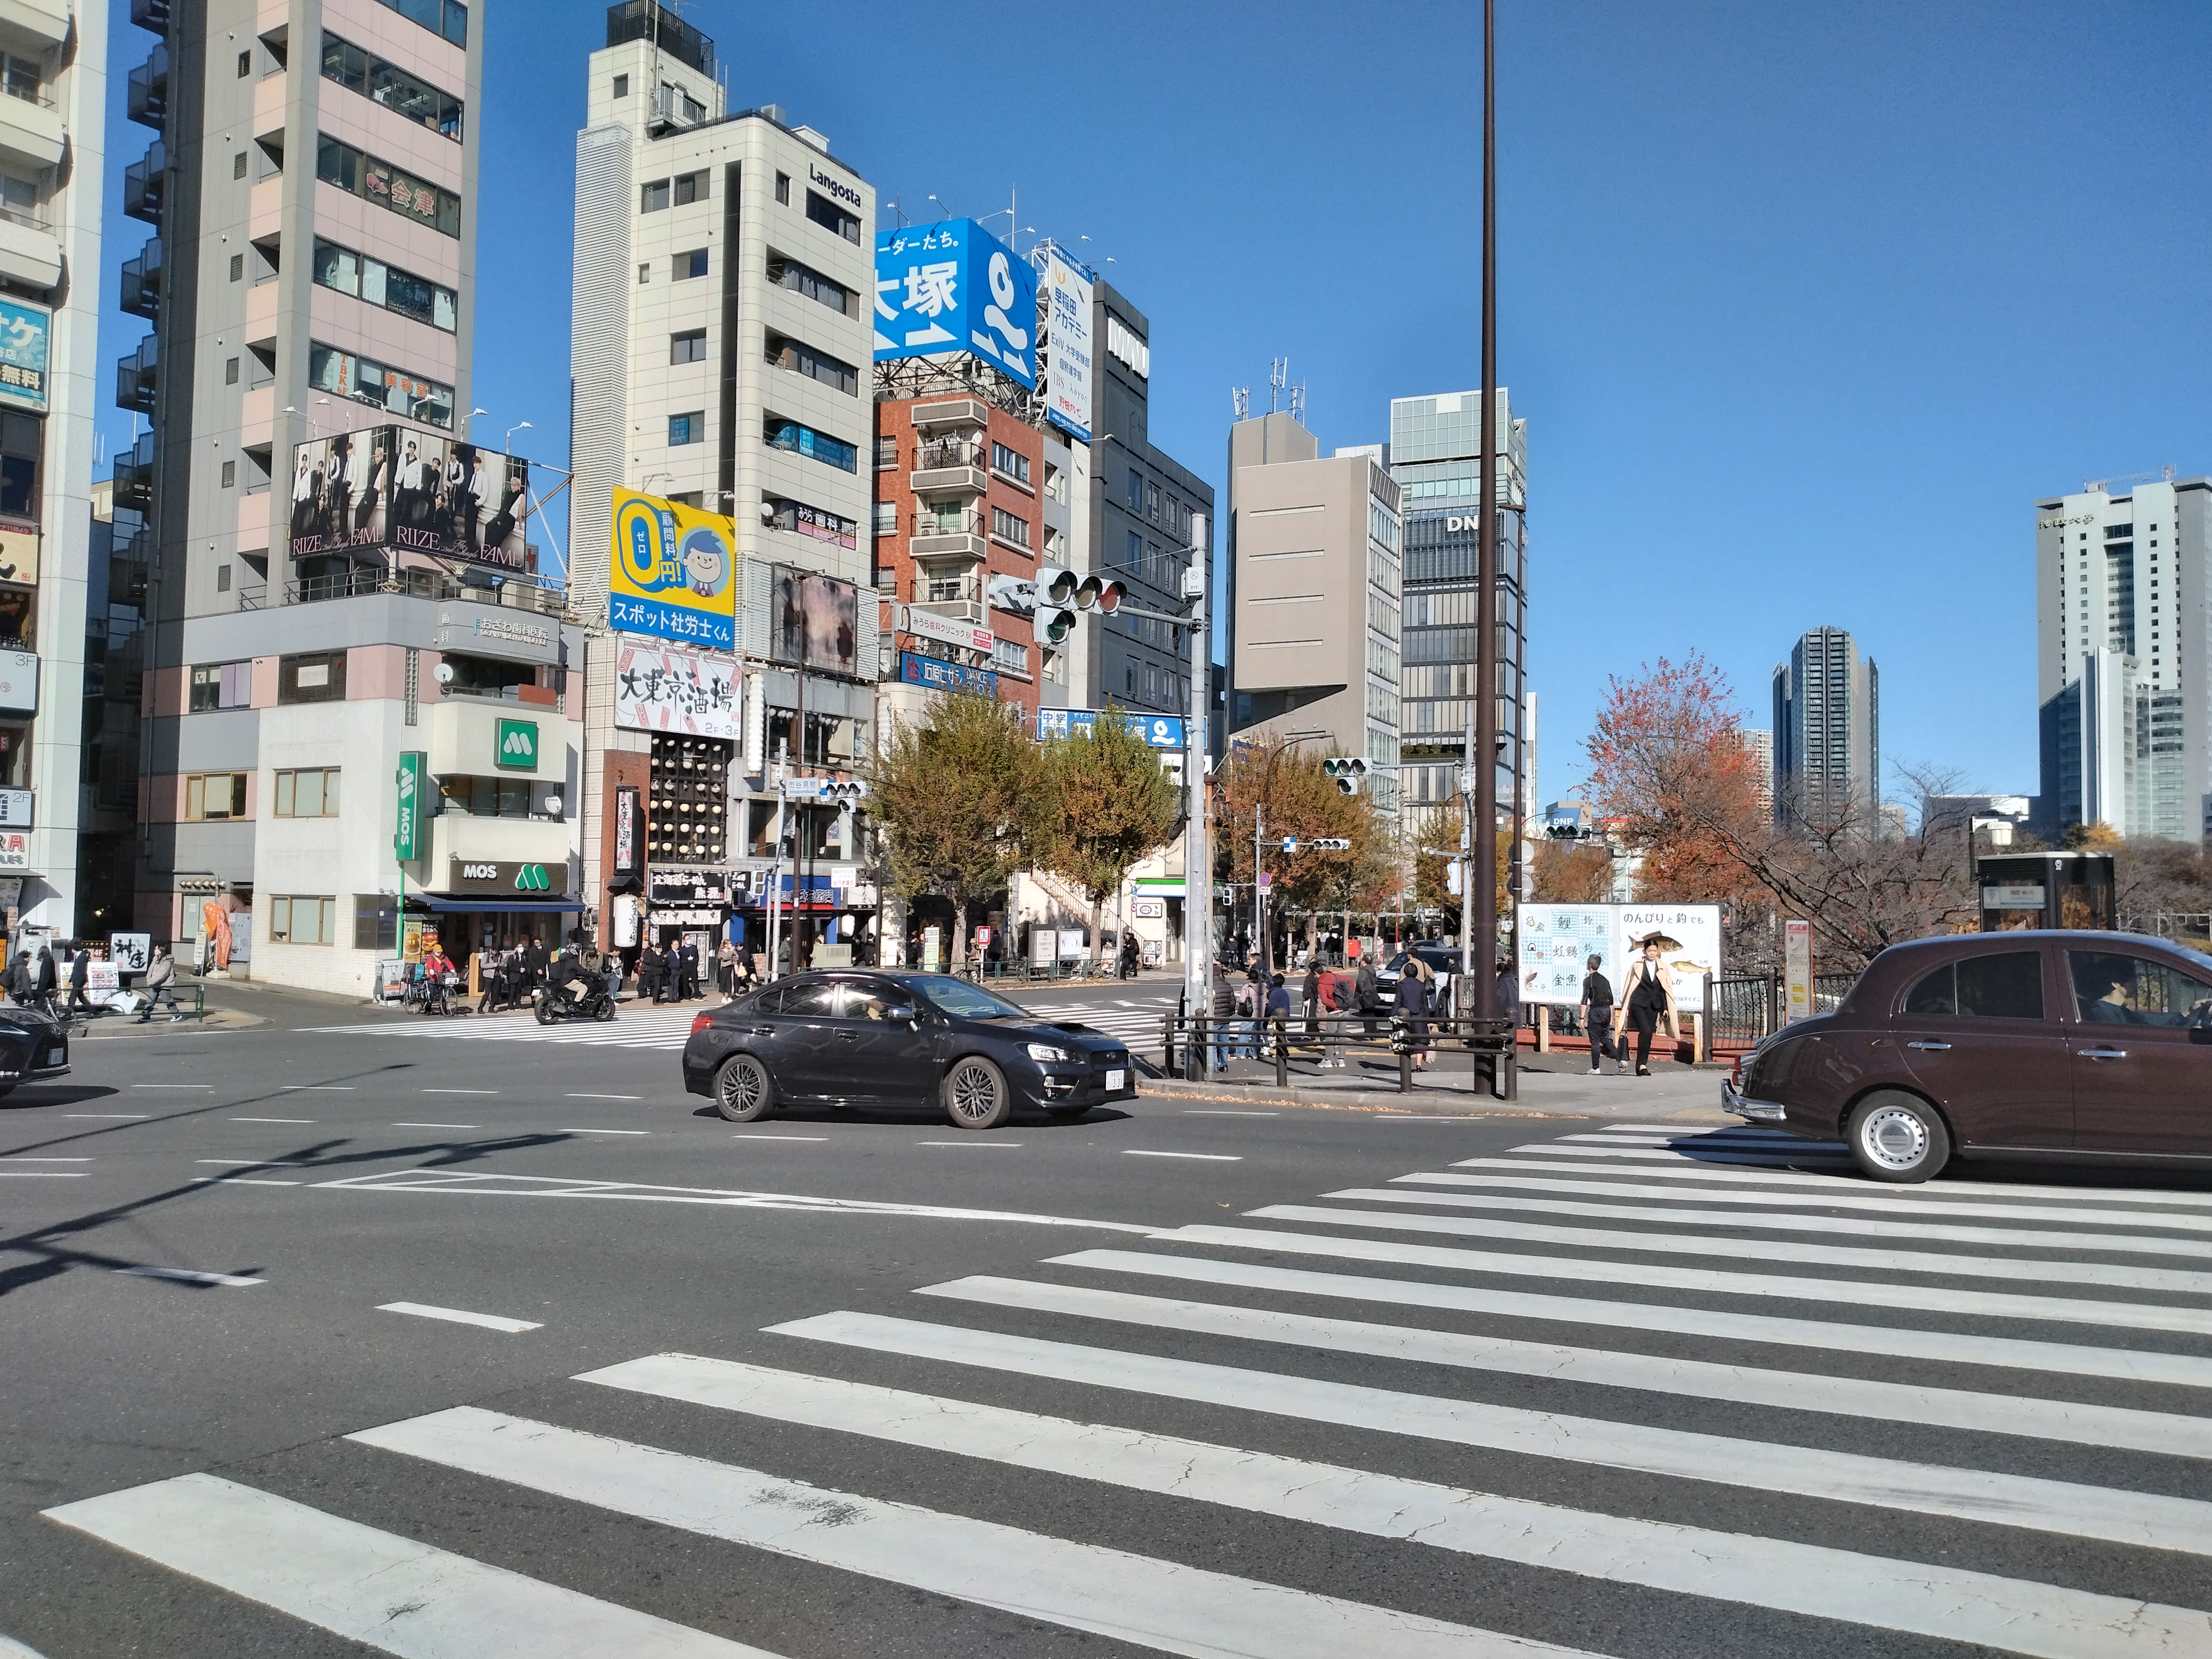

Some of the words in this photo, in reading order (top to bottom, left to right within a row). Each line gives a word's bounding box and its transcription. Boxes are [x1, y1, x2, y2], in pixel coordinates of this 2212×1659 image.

[810, 162, 860, 208] Langosta
[1055, 286, 1076, 316] 早稲田
[1055, 306, 1087, 340] アカデミー
[1052, 332, 1064, 350] ExiV
[339, 354, 348, 386] TBK
[1053, 372, 1065, 389] IBS
[337, 387, 348, 395] 6F
[386, 373, 427, 397] 美容室
[293, 535, 322, 555] RIIZE
[350, 526, 384, 546] FAME
[397, 525, 440, 550] RIIZE
[480, 543, 522, 567] FAME
[636, 531, 646, 554] ゼロ
[662, 513, 676, 556] 顧問料
[659, 561, 682, 582] 円!
[441, 613, 450, 643] 歯科
[481, 618, 548, 639] おざわ歯科医院
[614, 602, 730, 642] スポット社労士くん
[913, 616, 965, 638] みうら歯科クリニック
[15, 654, 35, 667] 3F
[620, 667, 734, 715] 大東京酒場
[13, 792, 30, 803] 2F
[401, 807, 410, 846] MOS
[619, 801, 630, 850] 大東京酒場
[464, 864, 497, 878] MOS
[1557, 915, 1571, 929] 鯉
[1552, 974, 1577, 986] 金魚
